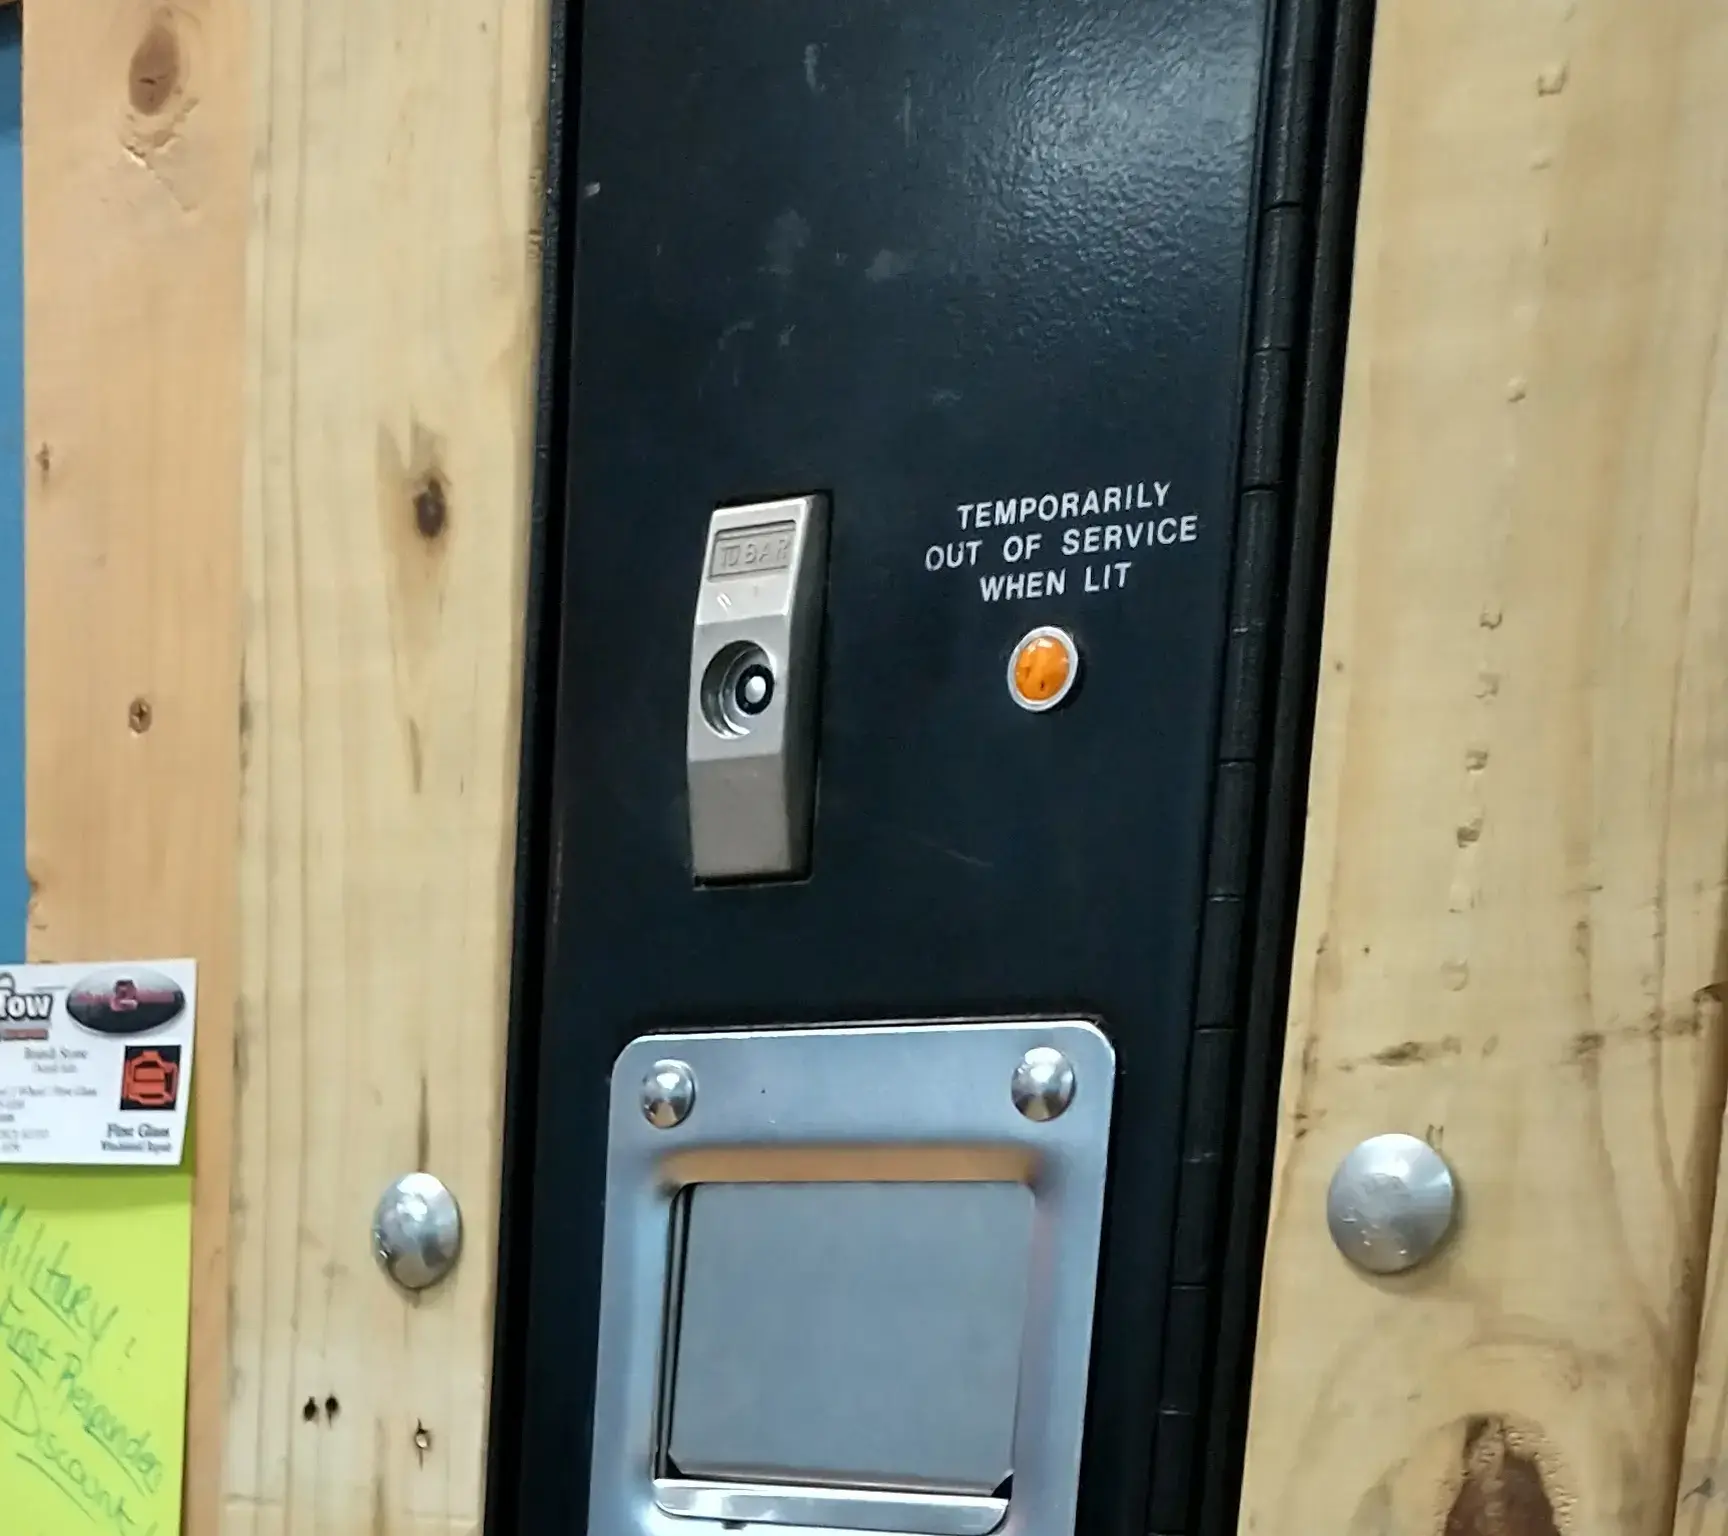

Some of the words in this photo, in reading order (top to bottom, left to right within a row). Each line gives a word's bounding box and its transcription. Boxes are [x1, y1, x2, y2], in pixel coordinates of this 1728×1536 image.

[957, 480, 1171, 531] TEMPORARILY
[925, 540, 983, 573] OUT
[1003, 533, 1042, 564] OF
[1061, 515, 1200, 556] SERVICE
[979, 569, 1066, 602] WHEN
[1083, 561, 1132, 593] LIT
